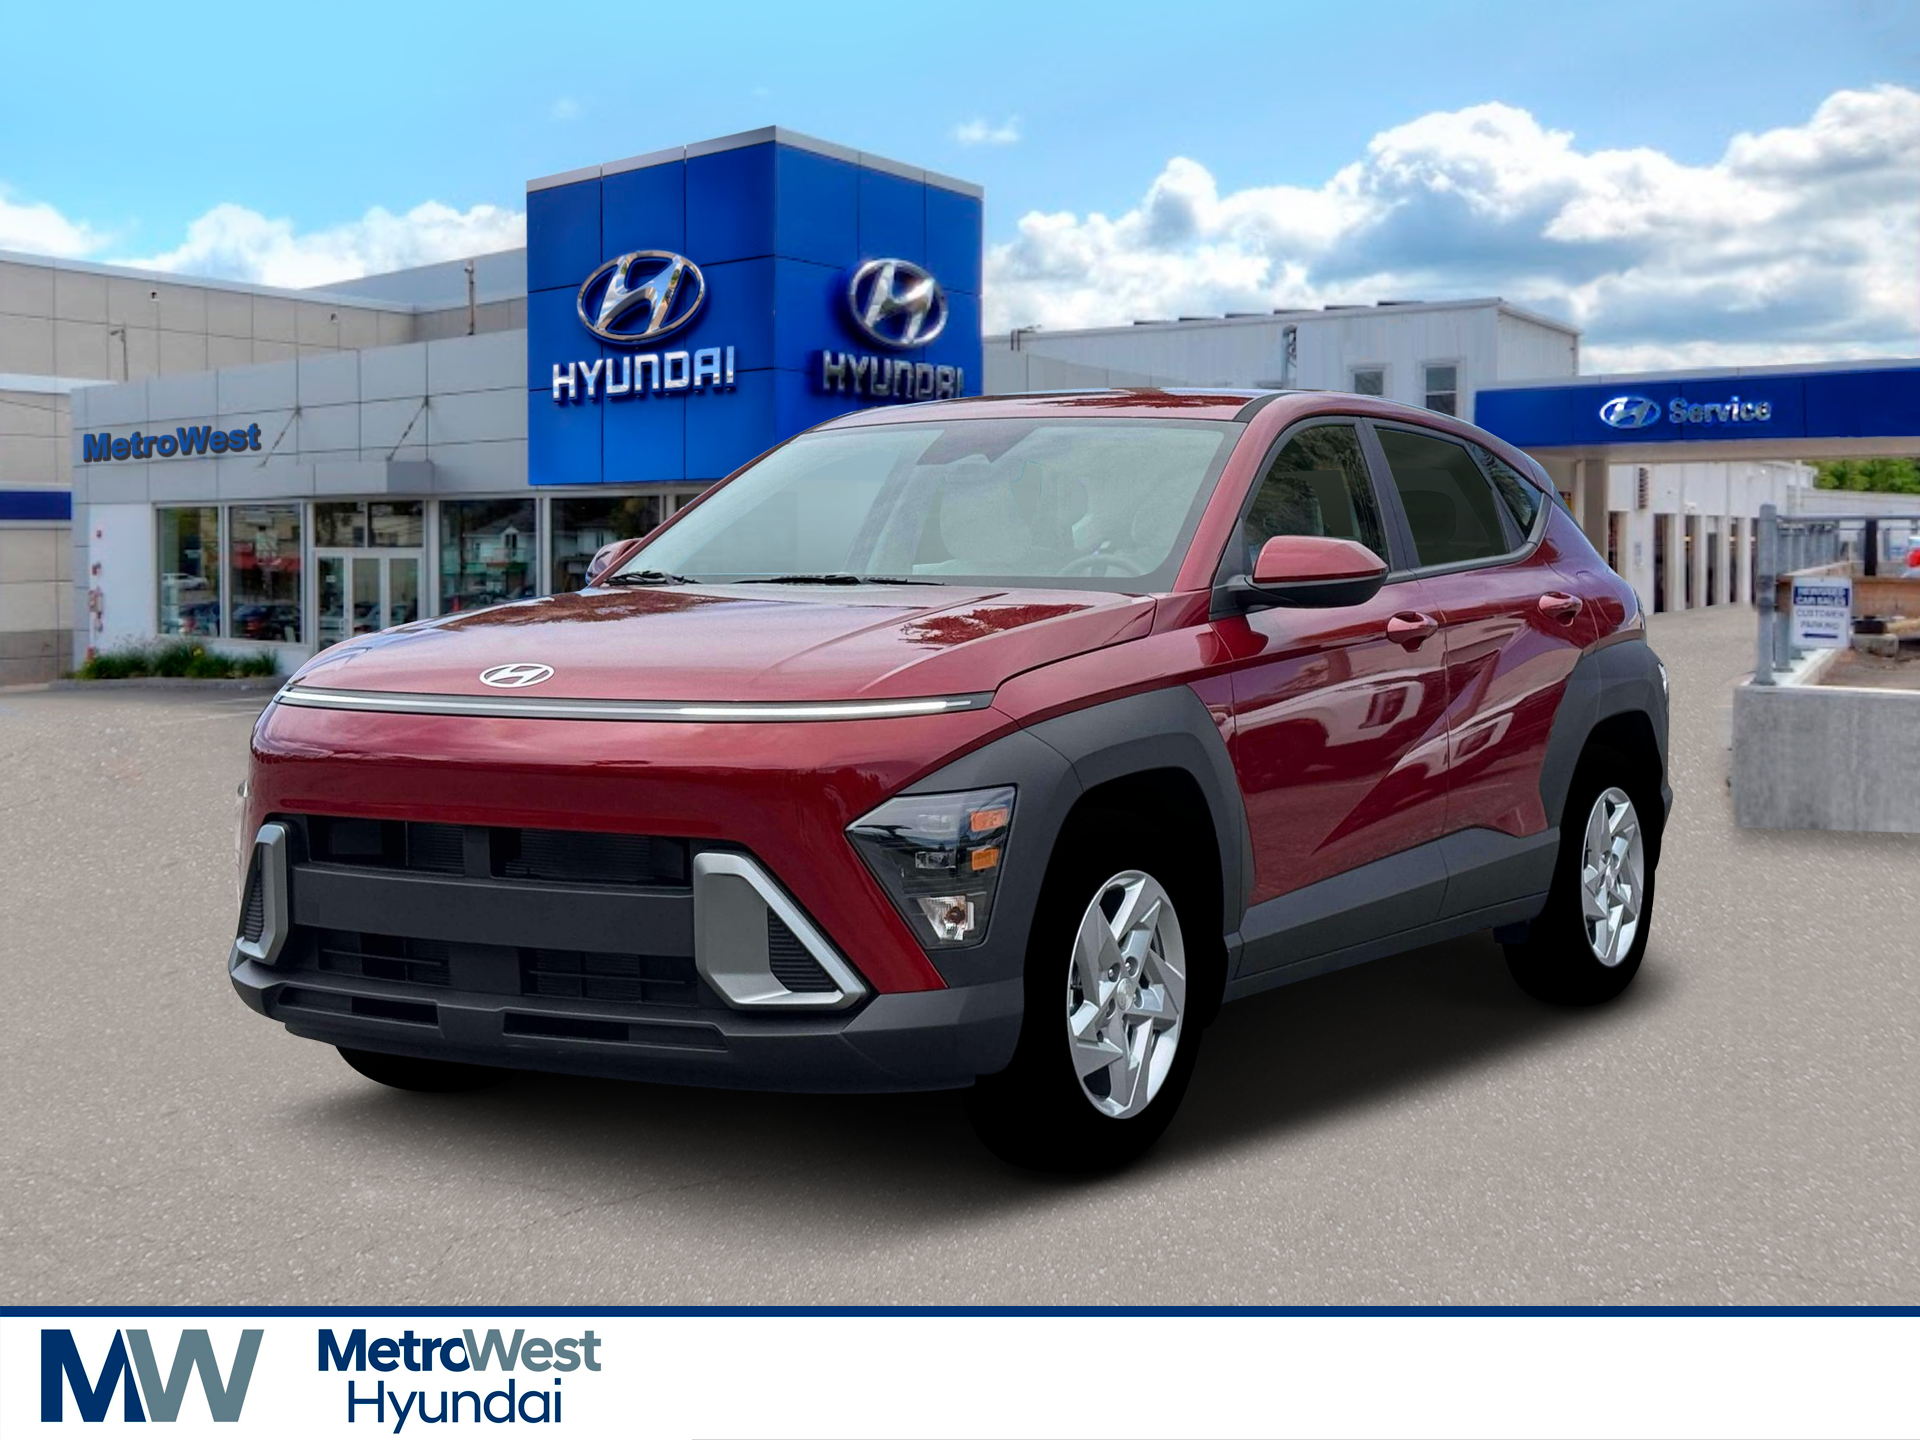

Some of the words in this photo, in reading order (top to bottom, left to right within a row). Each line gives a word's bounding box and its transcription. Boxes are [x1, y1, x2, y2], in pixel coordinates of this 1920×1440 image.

[552, 345, 735, 399] HYUNDAI
[822, 350, 965, 400] HYUNDAI
[1668, 396, 1772, 424] Service
[83, 423, 262, 463] MetroWest
